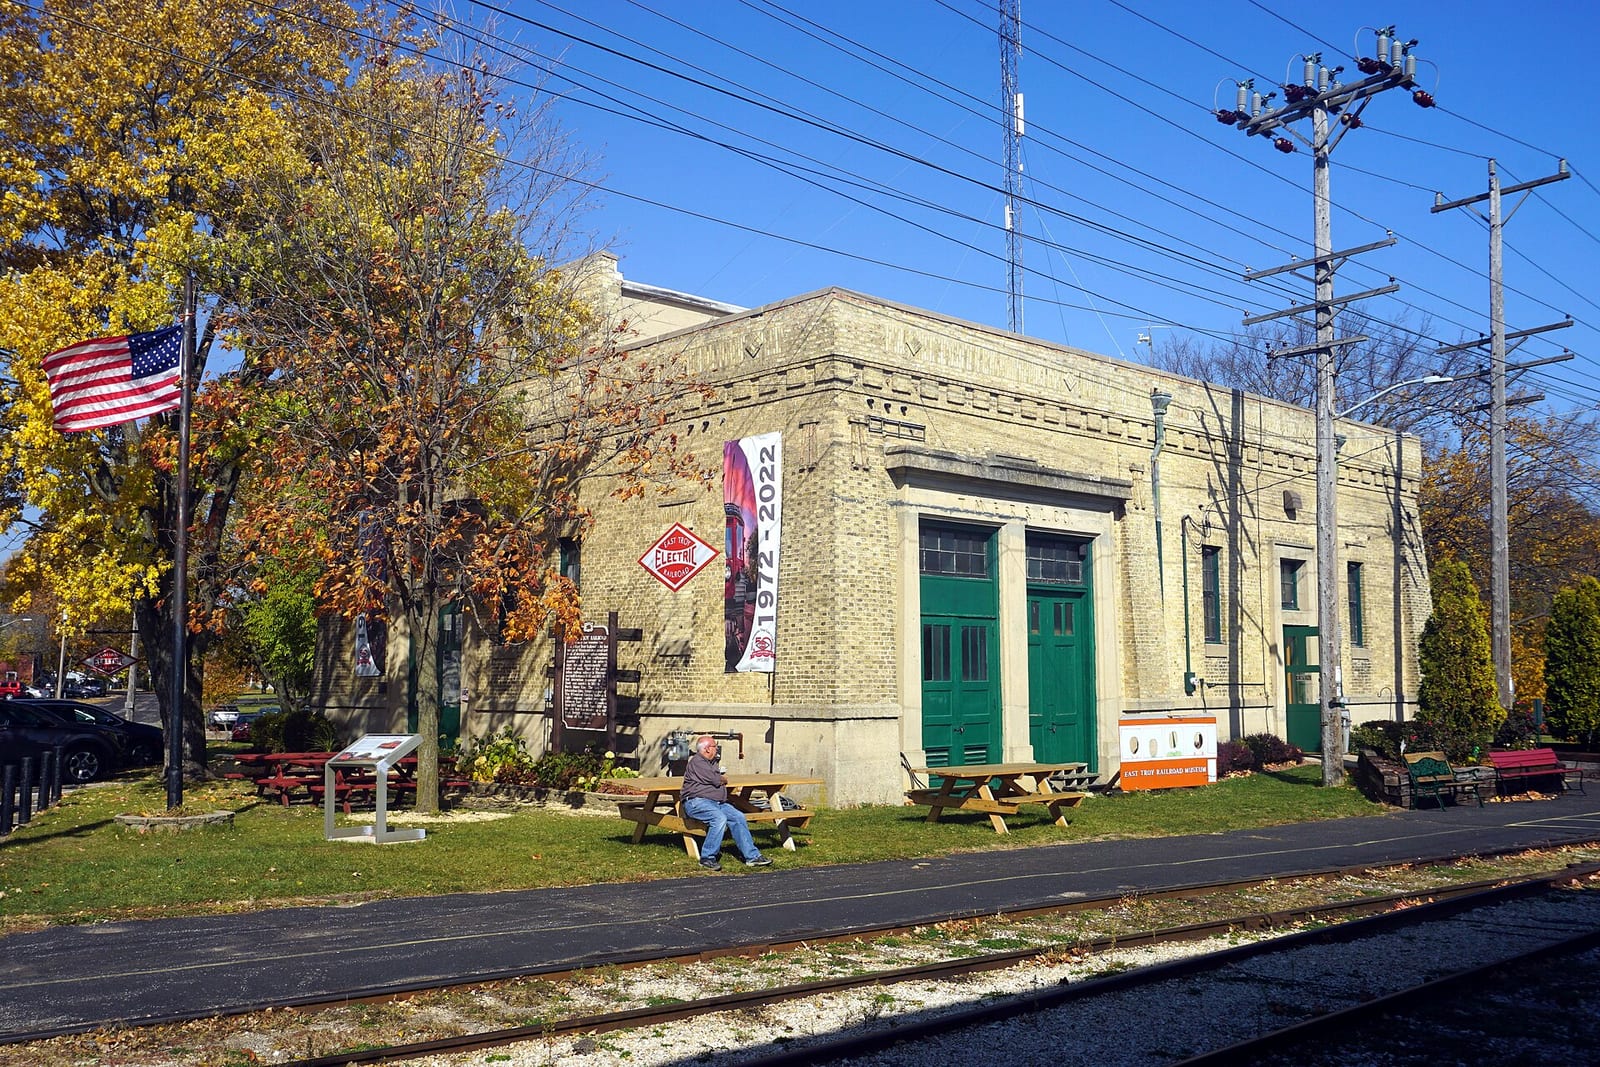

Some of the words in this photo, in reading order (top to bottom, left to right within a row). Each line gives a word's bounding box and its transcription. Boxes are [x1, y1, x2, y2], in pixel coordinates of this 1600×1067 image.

[758, 444, 776, 522] 2022
[664, 537, 677, 548] EAST
[677, 536, 691, 546] TROY
[655, 545, 697, 569] ELECTRIC
[663, 566, 690, 578] RAILROAD
[757, 550, 774, 626] 1972
[1124, 770, 1138, 778] EAST
[1140, 768, 1154, 776] TROY
[1156, 766, 1184, 776] RAILROAD
[1184, 766, 1207, 774] MUSEUM
